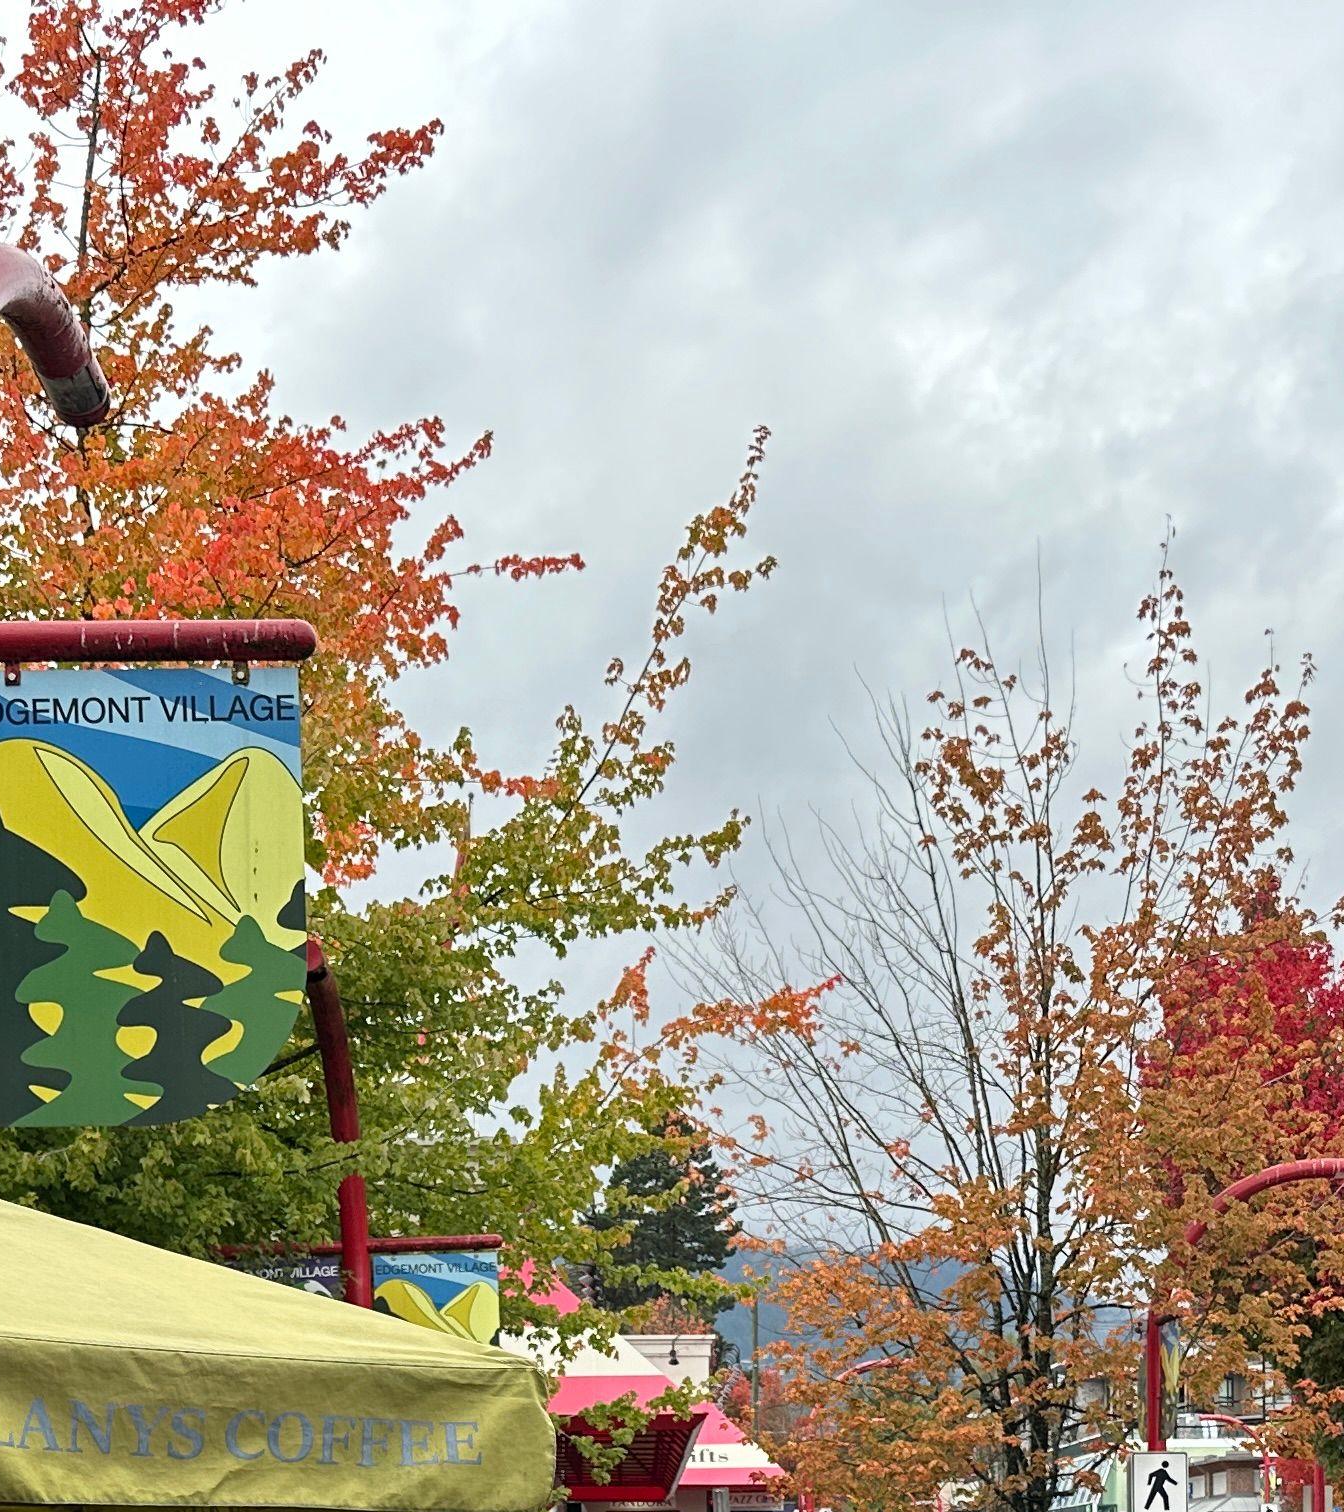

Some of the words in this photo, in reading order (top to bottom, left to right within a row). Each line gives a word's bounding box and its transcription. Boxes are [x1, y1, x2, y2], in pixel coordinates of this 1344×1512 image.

[162, 693, 296, 725] VILLAGE
[376, 1261, 443, 1276] EDGEMONT
[447, 1261, 497, 1273] VILLAGE
[224, 1408, 483, 1467] COFFEE
[690, 1448, 729, 1463] ifts
